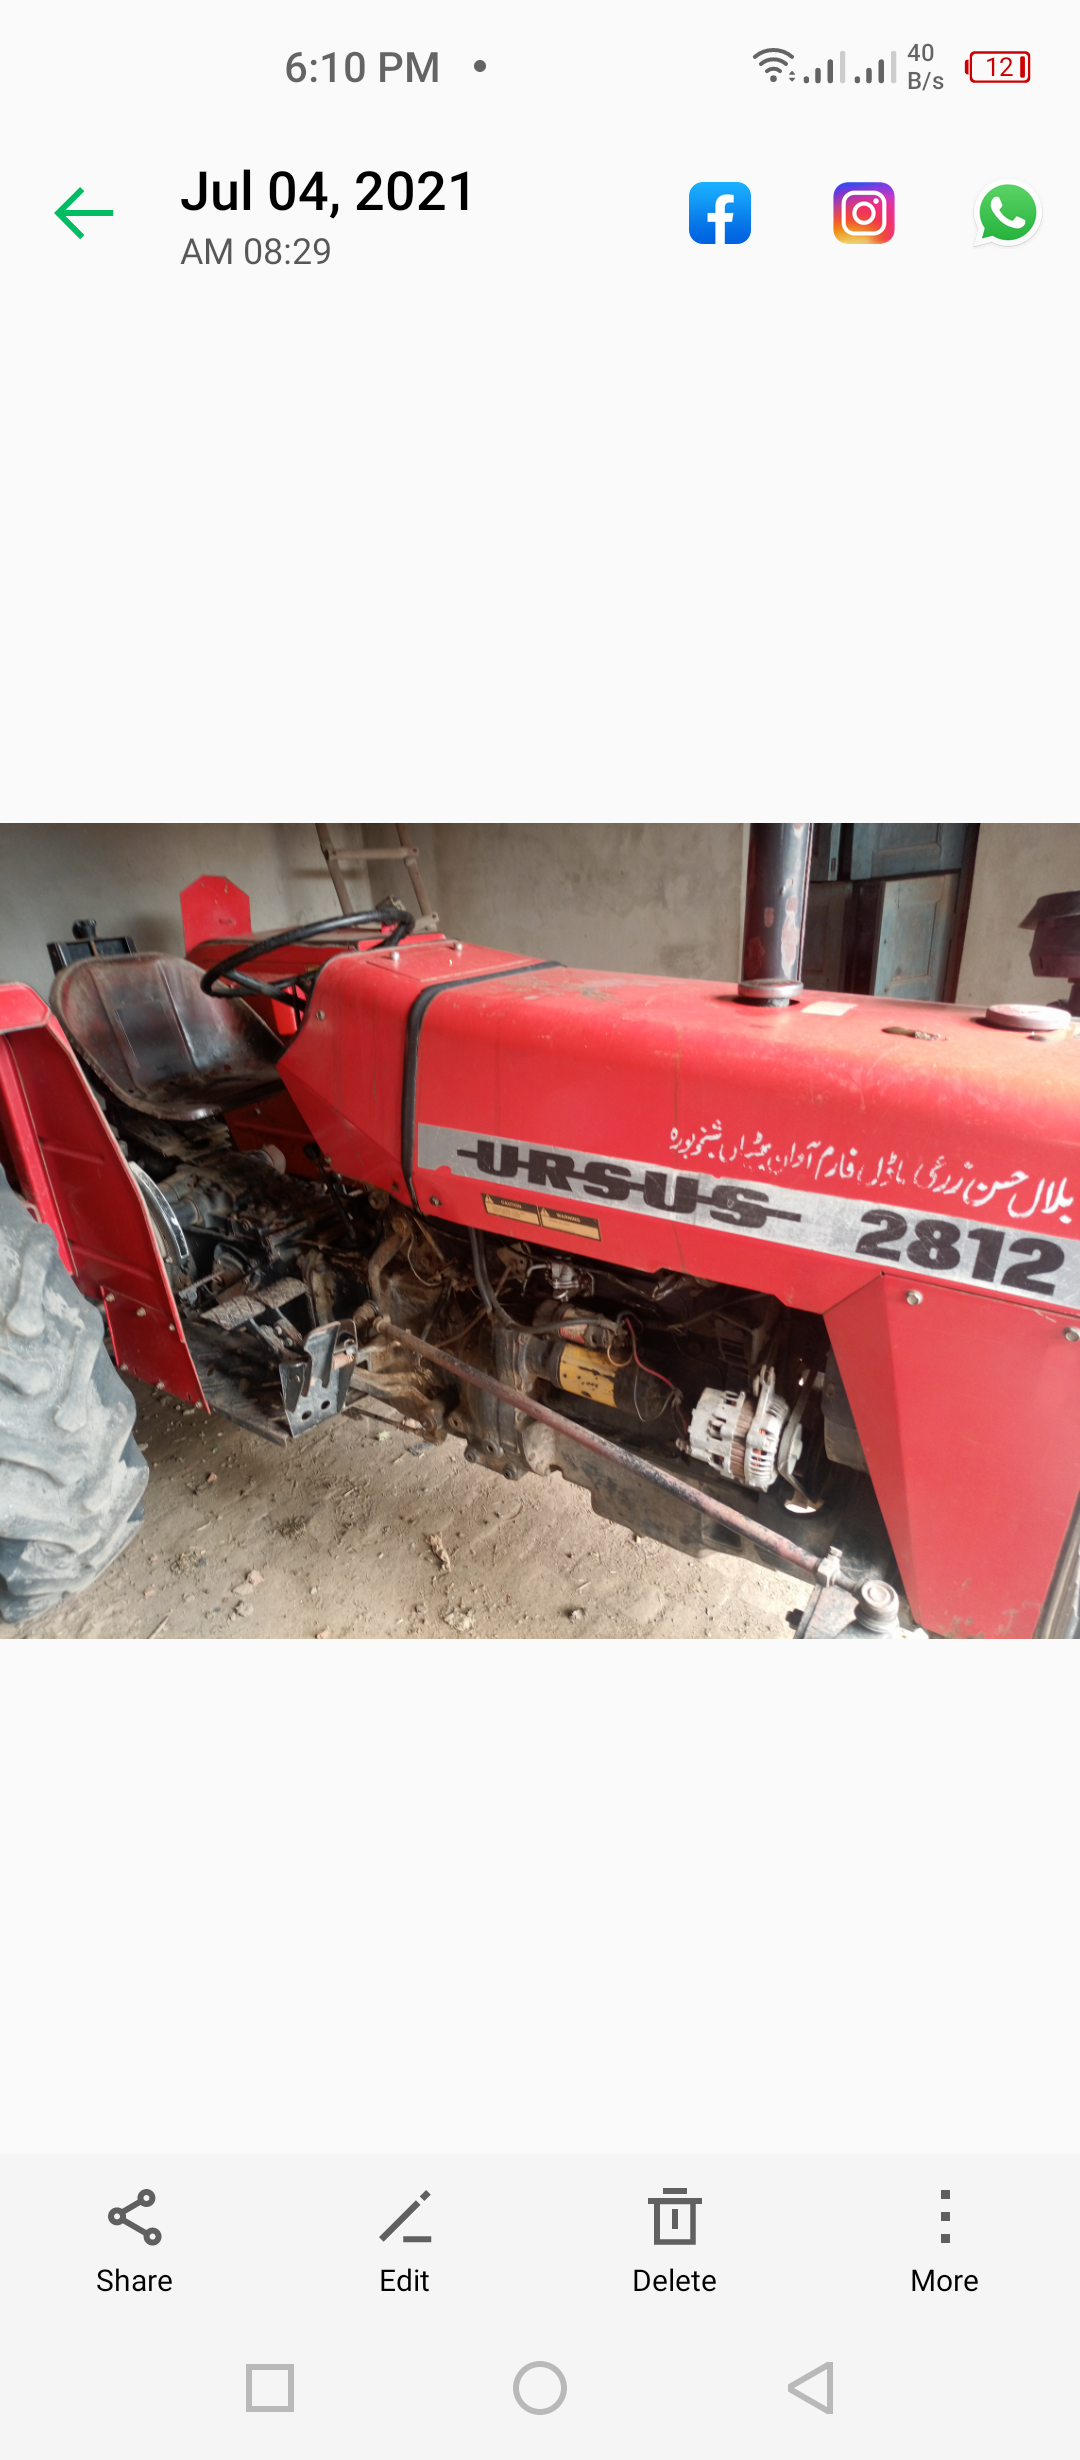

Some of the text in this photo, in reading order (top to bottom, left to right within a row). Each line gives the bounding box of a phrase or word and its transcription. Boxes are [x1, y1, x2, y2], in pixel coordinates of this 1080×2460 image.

[907, 44, 933, 62] 40
[986, 56, 1014, 77] 12
[286, 52, 439, 83] 6:10 PM
[908, 72, 944, 91] B/s
[181, 169, 468, 220] Jul 04, 2021
[181, 238, 331, 265] AM 08:29
[814, 1146, 858, 1181] فارم
[472, 1139, 774, 1229] URSUS
[962, 1171, 1029, 1207] حسن
[1007, 1177, 1073, 1224] بلال
[855, 1210, 1066, 1296] 2812
[96, 2267, 173, 2292] Share
[380, 2267, 430, 2292] Edit
[633, 2267, 717, 2292] Delete
[911, 2268, 979, 2292] More
